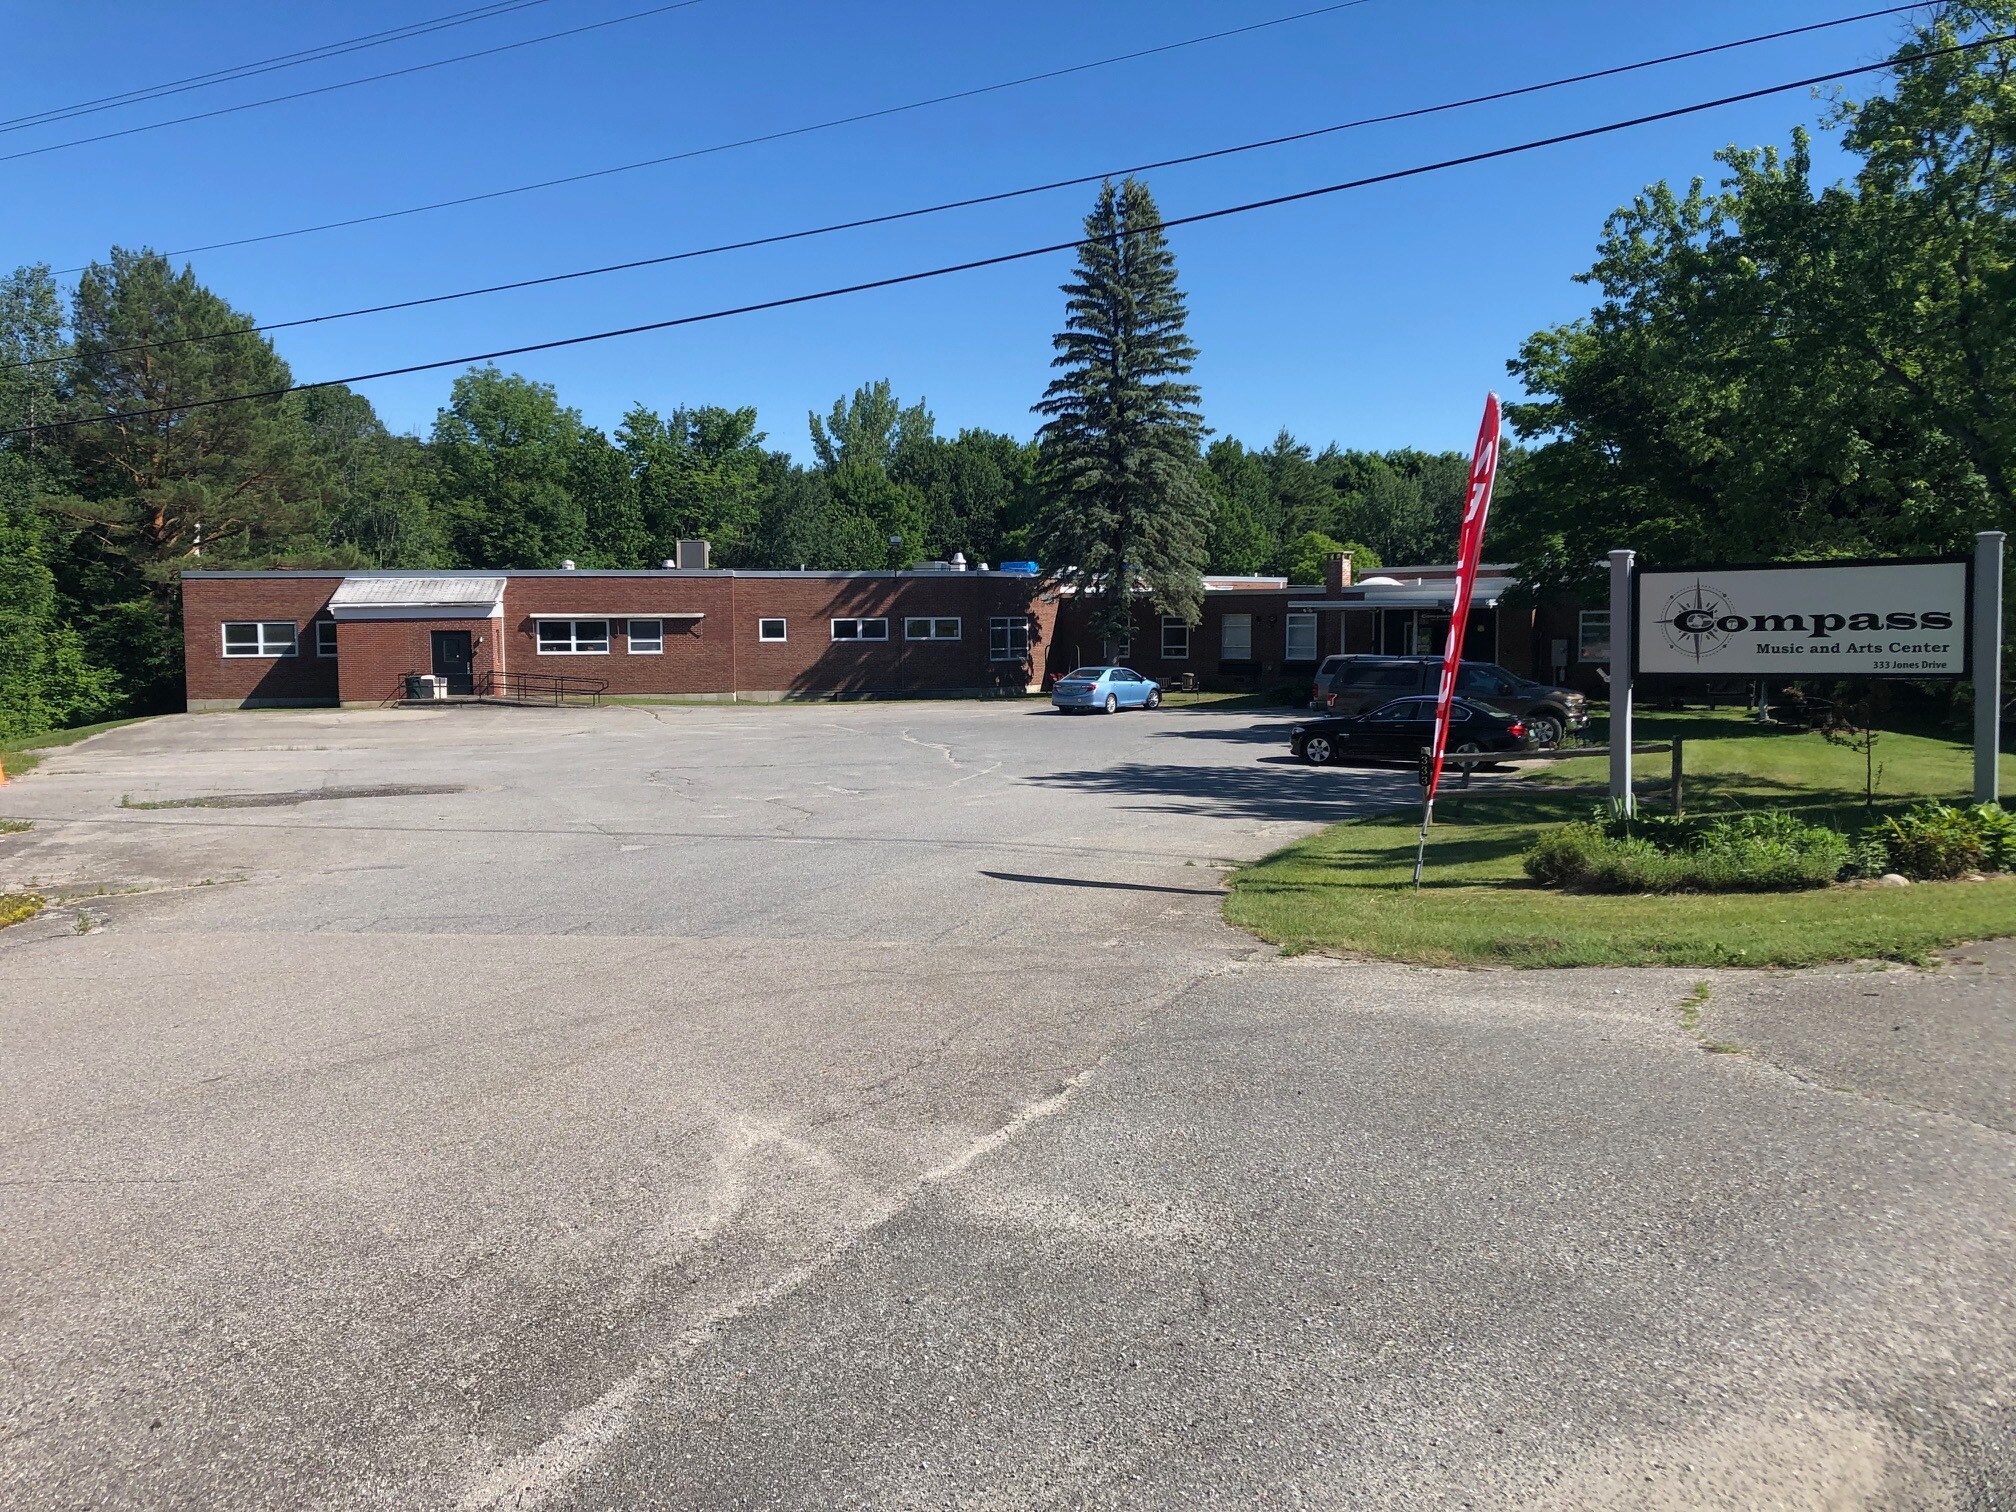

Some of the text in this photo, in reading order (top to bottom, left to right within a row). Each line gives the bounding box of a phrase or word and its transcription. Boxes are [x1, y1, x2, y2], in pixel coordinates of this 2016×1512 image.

[1673, 609, 1953, 638] Compass
[1756, 642, 1950, 654] Music and Arts Center
[1873, 661, 1947, 669] 333 Jones Drive
